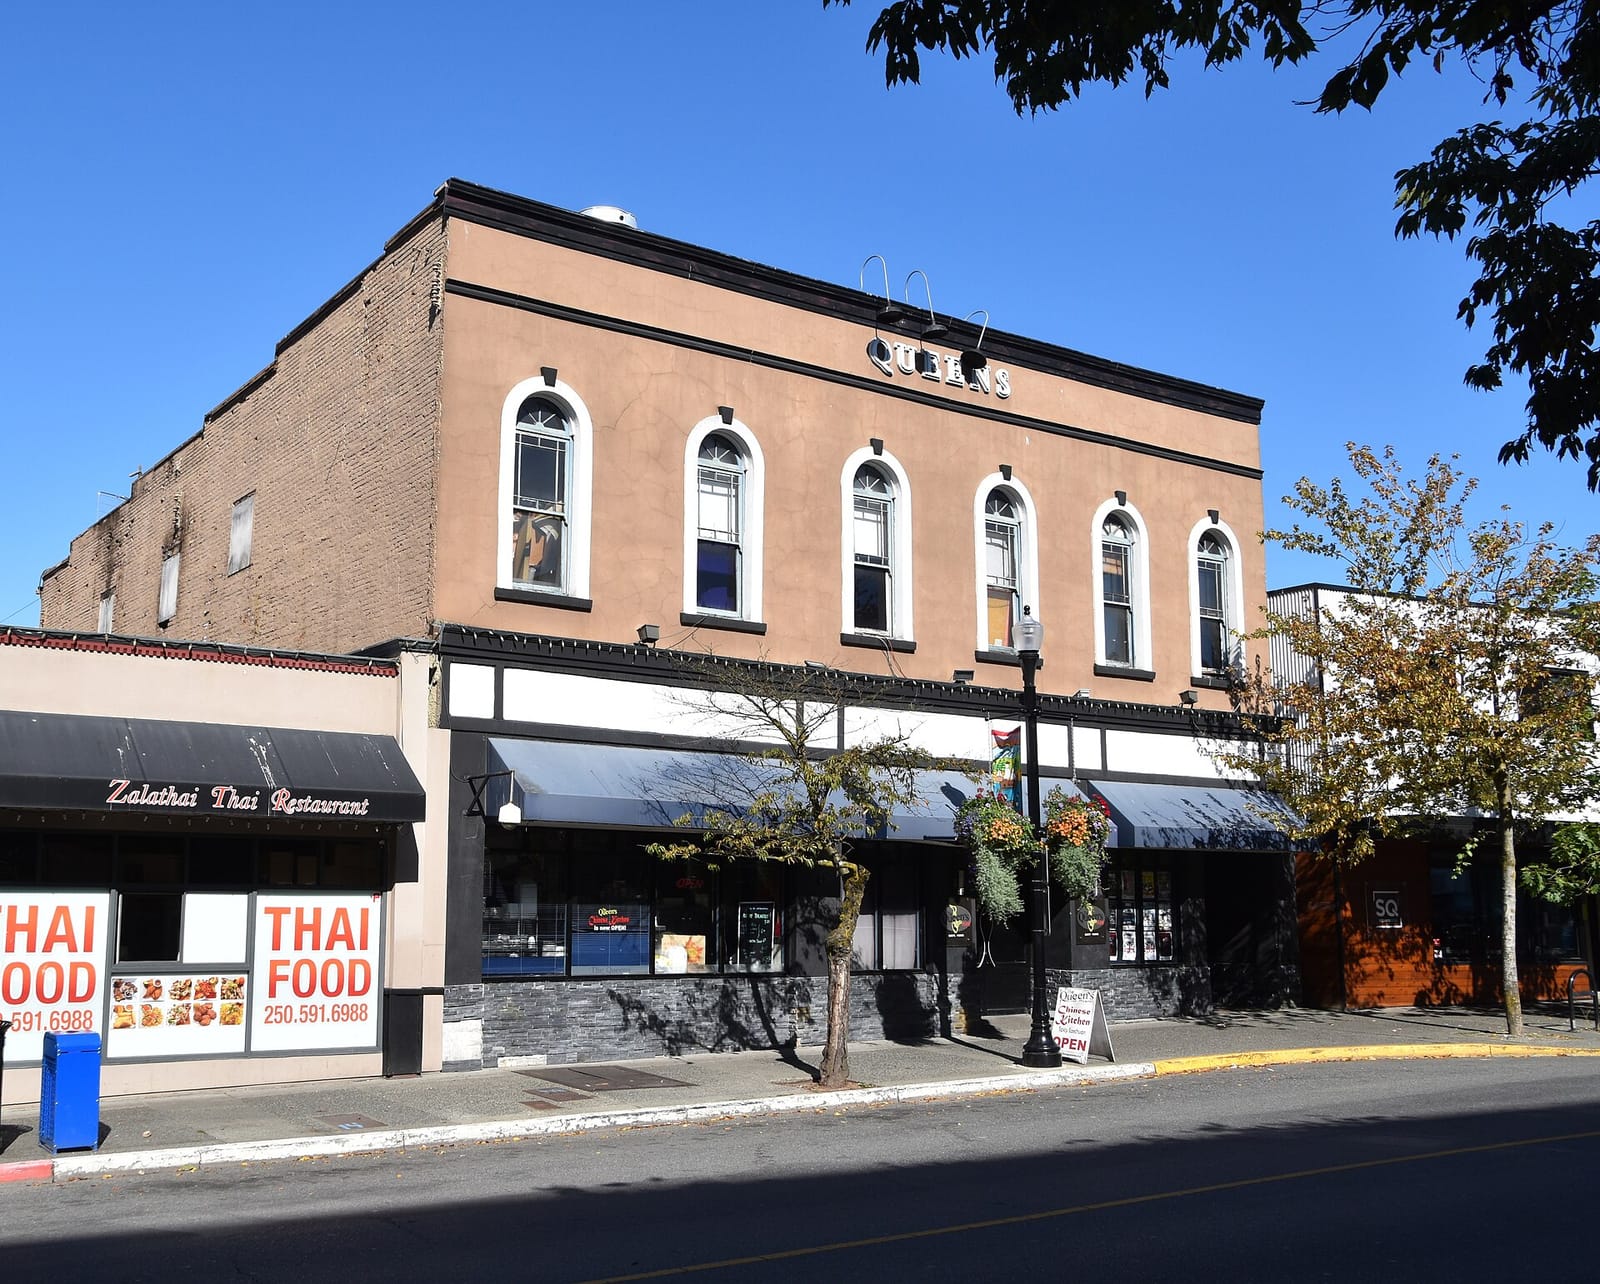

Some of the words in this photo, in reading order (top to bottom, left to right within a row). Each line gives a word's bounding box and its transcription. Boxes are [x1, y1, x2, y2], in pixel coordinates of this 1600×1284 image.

[866, 337, 1012, 399] QUEENS
[106, 779, 200, 807] Zalathai
[211, 786, 261, 810] Thai
[271, 787, 369, 815] Restaurant
[1375, 899, 1399, 917] SQ
[0, 905, 95, 953] HAI
[264, 906, 369, 951] THAI
[1, 961, 97, 1005] OOD
[268, 958, 372, 998] FOOD
[0, 1010, 93, 1032] 591.6988
[264, 1003, 368, 1024] 250.591.6988
[1055, 1014, 1090, 1026] Kitchen
[1058, 1005, 1091, 1015] Chinese
[1054, 1036, 1086, 1051] OPEN
